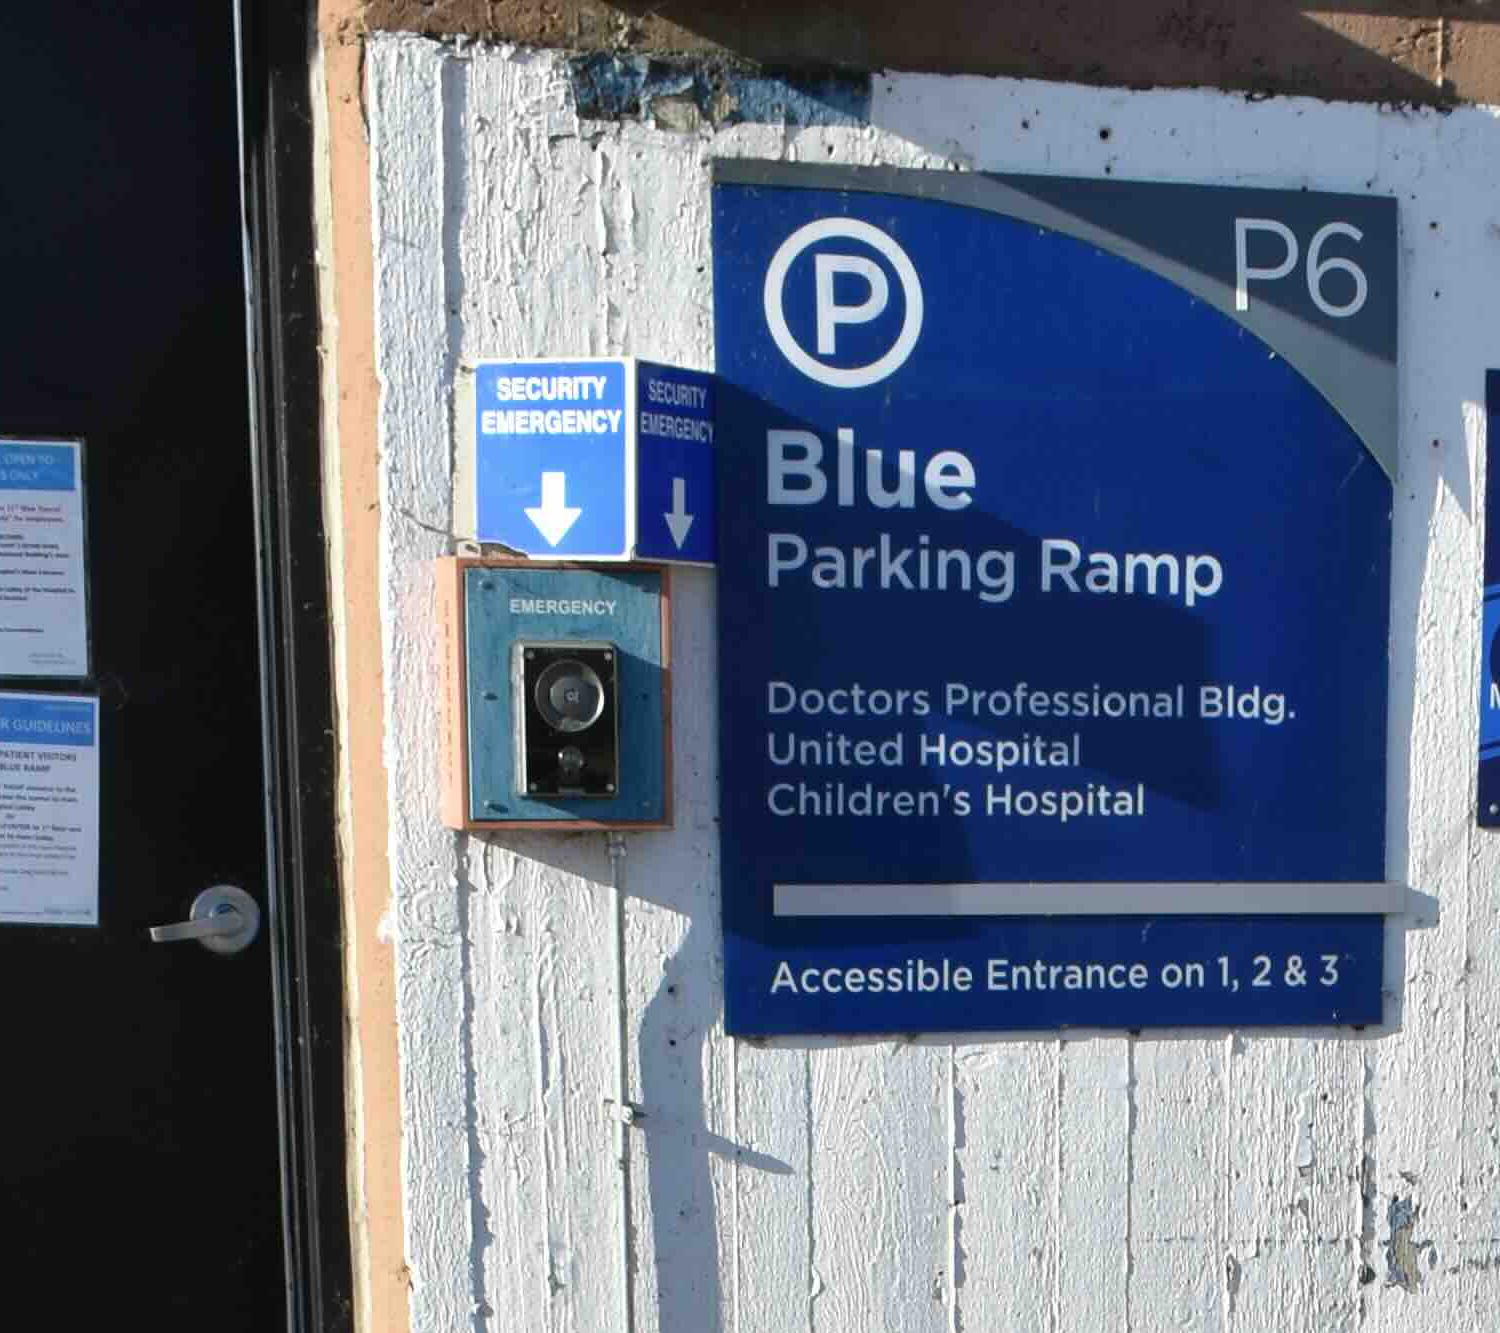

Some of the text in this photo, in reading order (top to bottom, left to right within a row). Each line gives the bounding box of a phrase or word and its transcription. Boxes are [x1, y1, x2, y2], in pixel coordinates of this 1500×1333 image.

[1233, 217, 1369, 317] P6
[496, 376, 606, 400] SECURITY
[648, 377, 707, 408] SECURITY
[482, 409, 621, 433] EMERGENCY
[640, 413, 714, 443] EMERGENCY
[767, 426, 976, 510] Blue
[767, 532, 1224, 606] Parking Ramp
[510, 598, 616, 615] EMERGENCY
[767, 680, 1295, 725] Doctors Professional Bldg.
[12, 719, 92, 735] GUIDELINES
[767, 731, 1079, 772] United Hospital
[767, 781, 1144, 822] Children's Hospital
[770, 954, 1339, 993] Accessible Entrance on 1, 2 & 3
